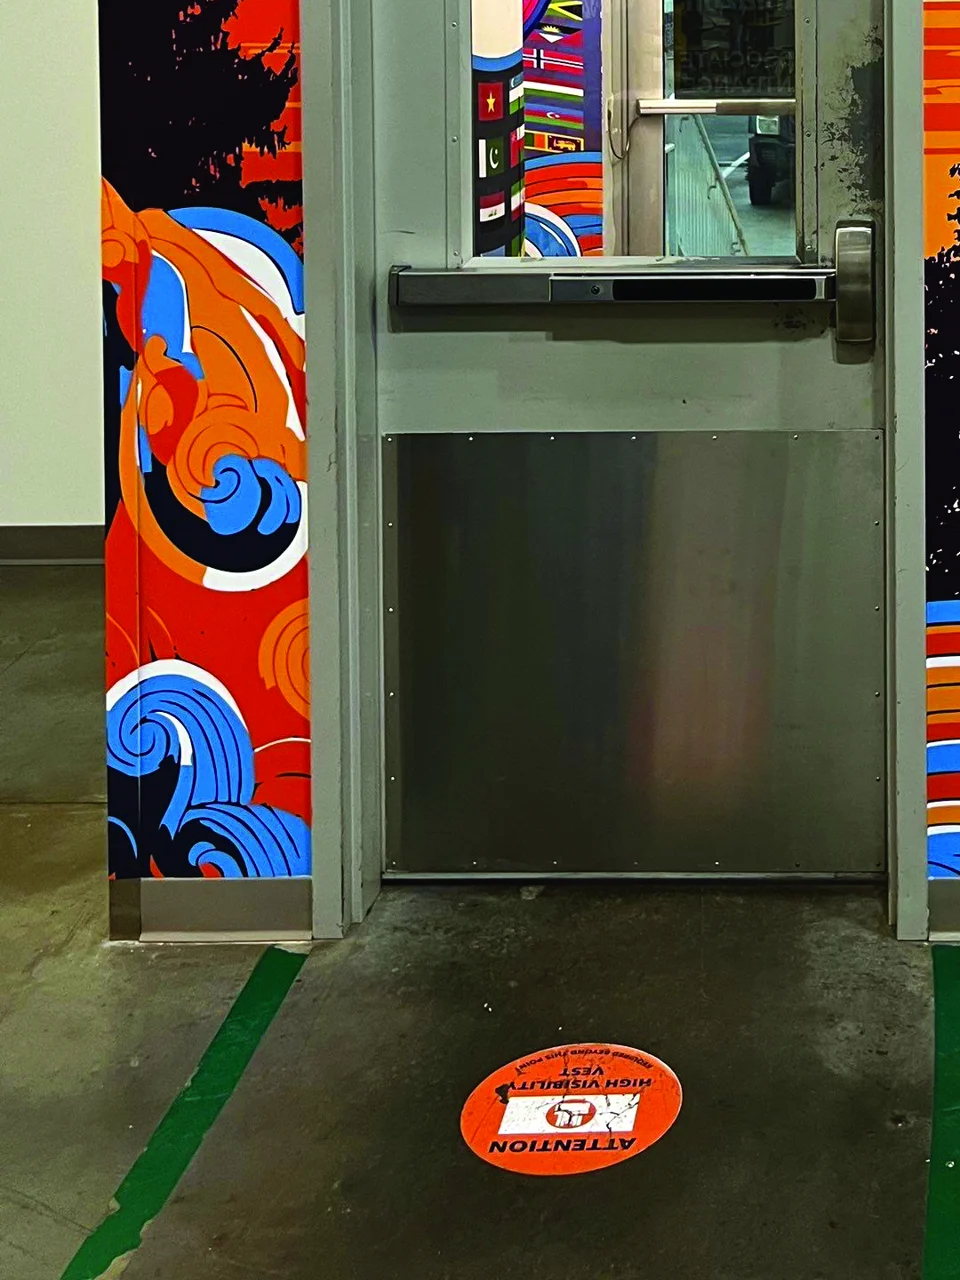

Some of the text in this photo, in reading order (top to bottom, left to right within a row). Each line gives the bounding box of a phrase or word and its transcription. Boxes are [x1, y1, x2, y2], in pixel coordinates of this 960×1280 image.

[514, 1056, 544, 1075] POINT
[559, 1066, 604, 1076] VEST
[506, 1077, 652, 1090] HIGH VISIBILITY
[488, 1137, 637, 1153] ATTENTION
